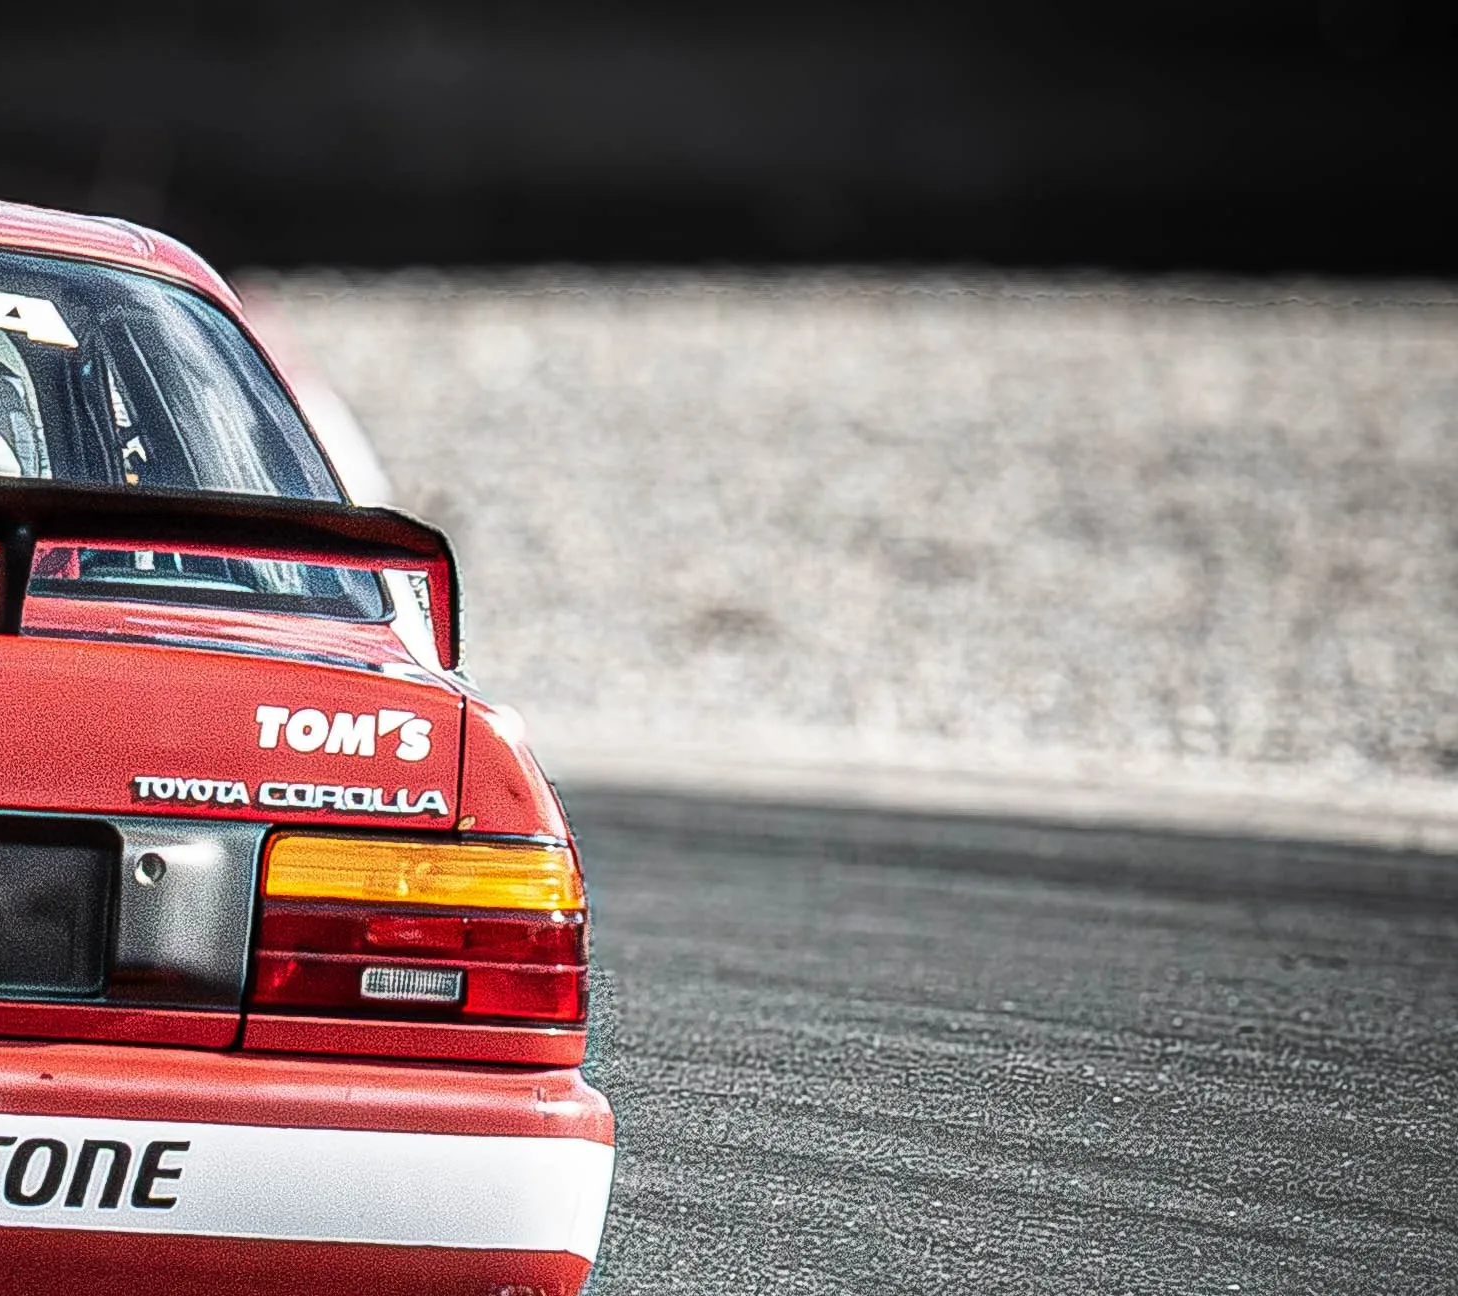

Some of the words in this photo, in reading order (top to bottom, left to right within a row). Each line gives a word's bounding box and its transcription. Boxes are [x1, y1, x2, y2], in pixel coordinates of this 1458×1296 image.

[255, 705, 432, 762] TOM'S
[134, 776, 250, 805] TOYOTA
[259, 781, 450, 815] COROLLA
